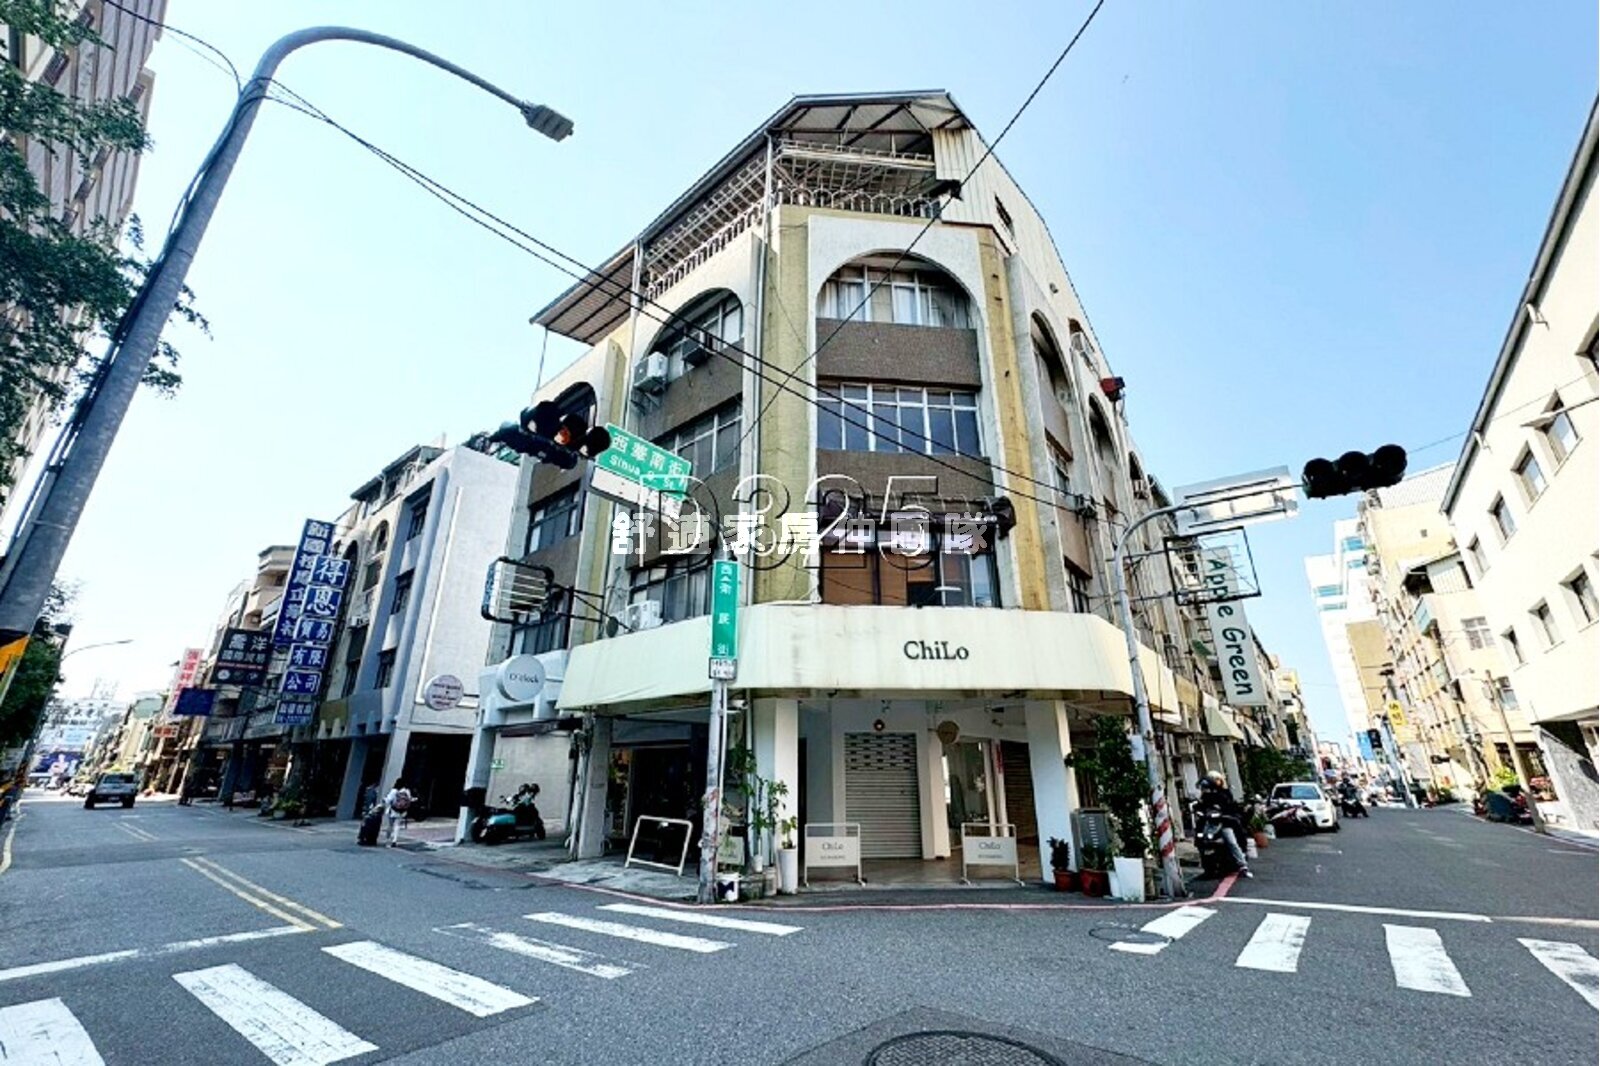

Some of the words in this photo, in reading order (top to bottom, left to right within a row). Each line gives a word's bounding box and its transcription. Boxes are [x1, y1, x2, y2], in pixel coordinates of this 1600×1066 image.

[609, 454, 641, 477] Sihua
[611, 432, 685, 487] 西華南街
[1204, 558, 1234, 618] Appe
[1221, 627, 1253, 696] Green
[903, 640, 969, 660] ChiLo
